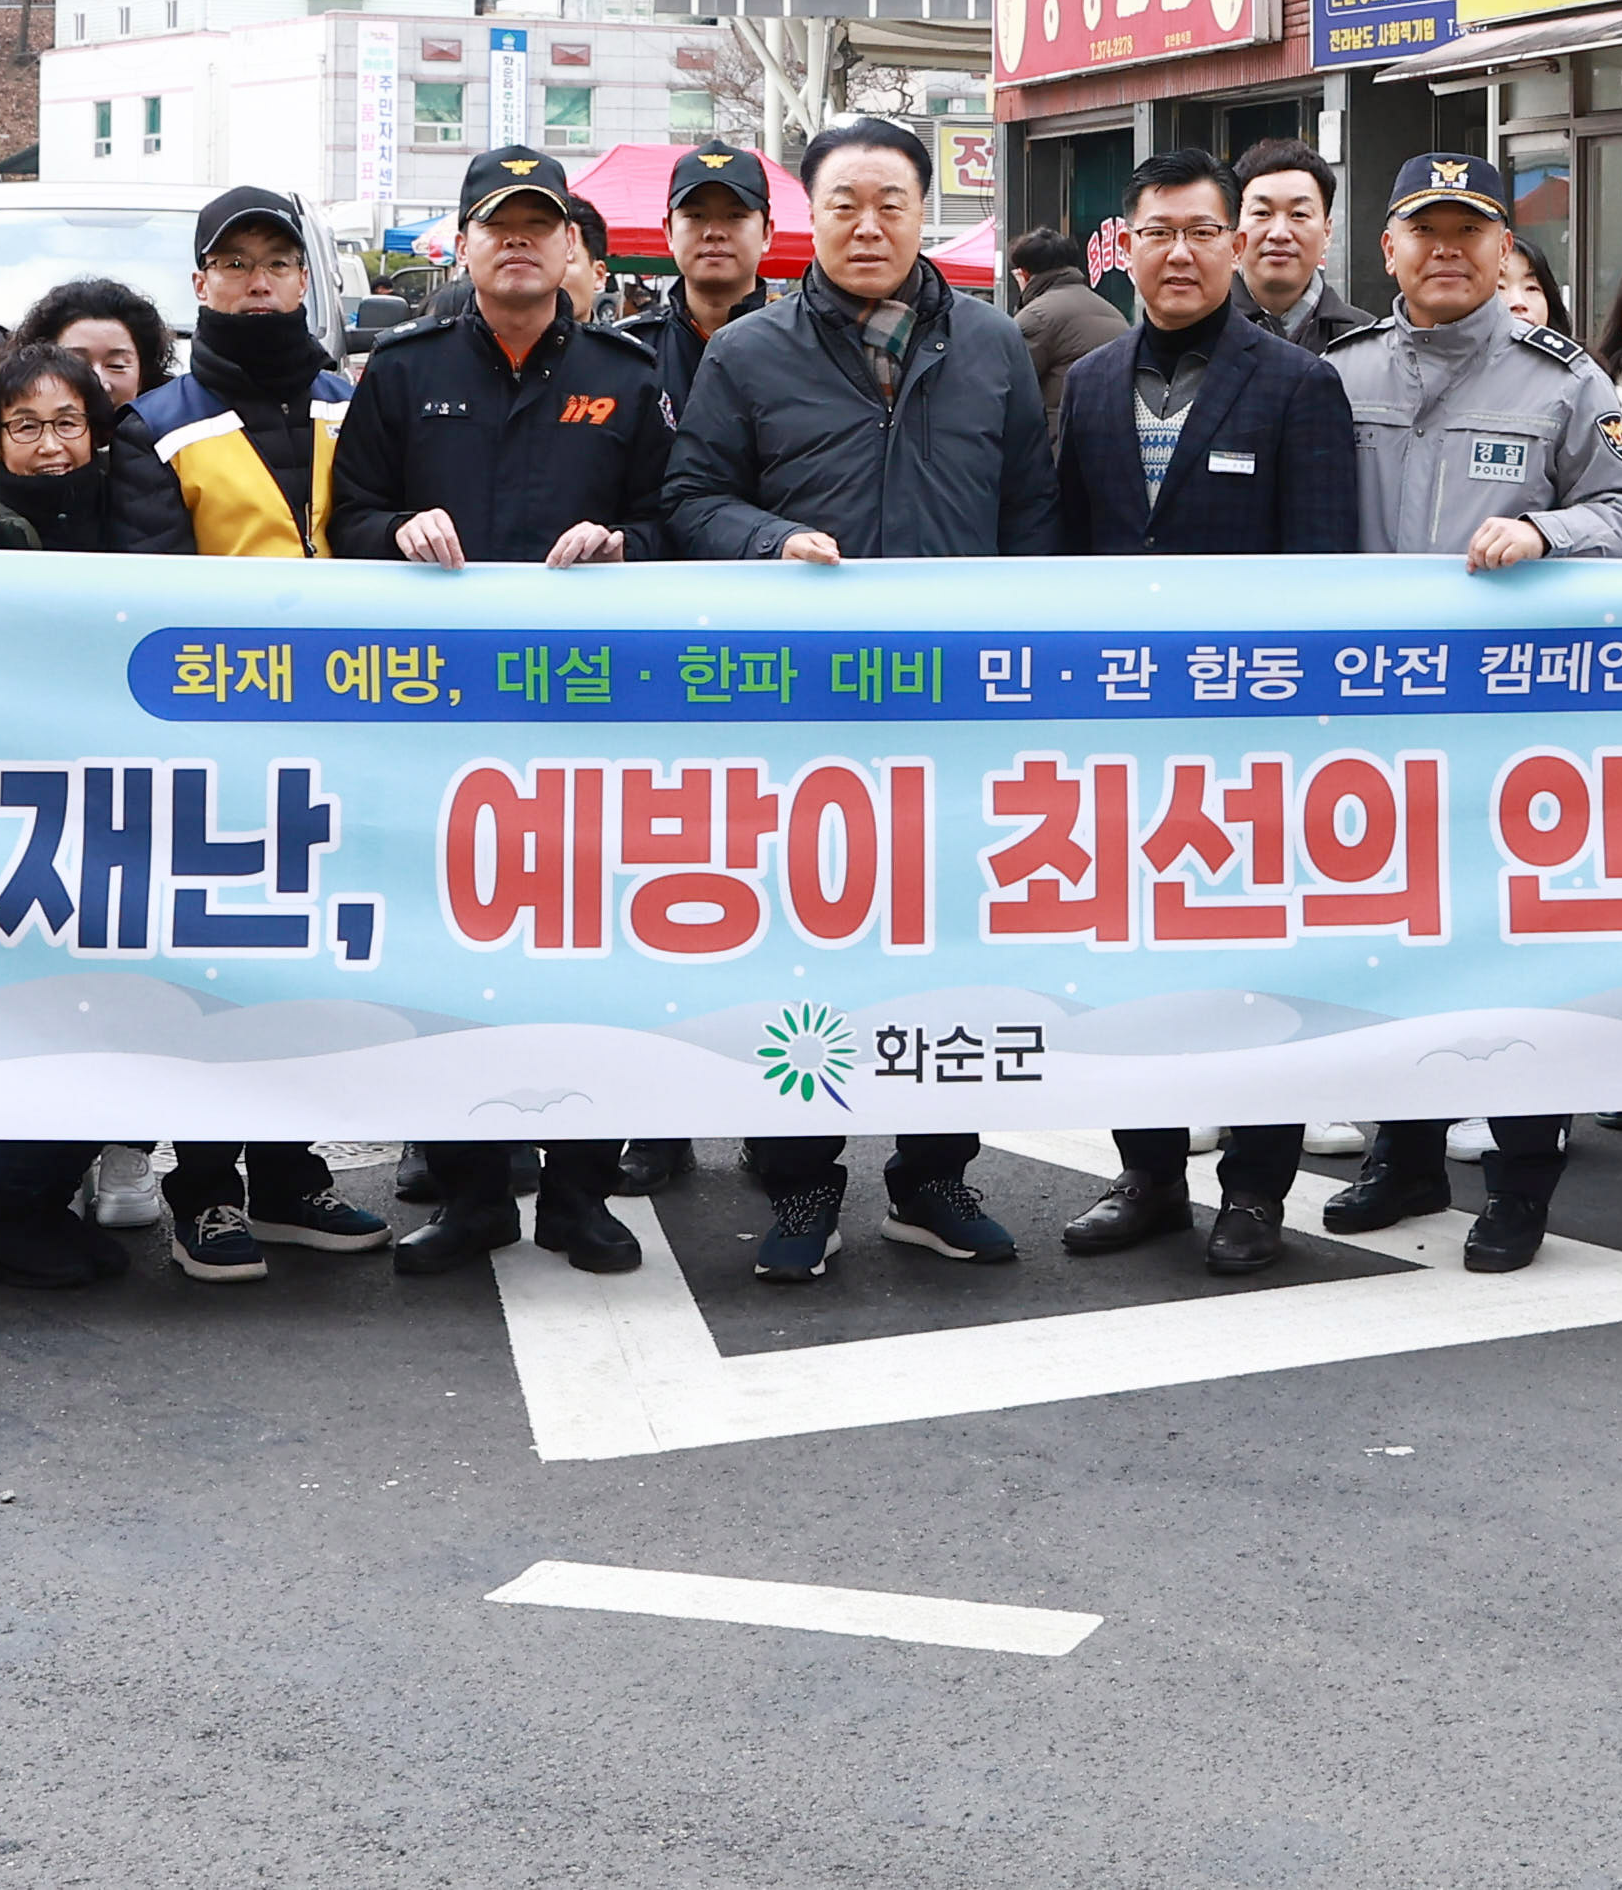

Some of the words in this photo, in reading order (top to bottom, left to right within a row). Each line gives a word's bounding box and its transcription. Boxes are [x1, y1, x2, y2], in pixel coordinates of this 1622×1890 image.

[1329, 24, 1375, 53] 전라남도
[1377, 17, 1436, 47] 사회적기업
[559, 397, 618, 425] 119
[1474, 465, 1521, 478] POLICE
[172, 644, 296, 704] 화재
[324, 643, 461, 708] 예방,
[496, 645, 614, 704] 대설
[678, 645, 798, 705] 한파
[830, 645, 943, 705] 대비
[978, 645, 1033, 703] 민
[1097, 645, 1158, 702] 관
[1185, 644, 1303, 702] 합동
[1334, 642, 1449, 699] 안전
[445, 763, 926, 955] 예방이
[986, 755, 1445, 946] 최선의
[873, 1021, 1048, 1087] 화순군
